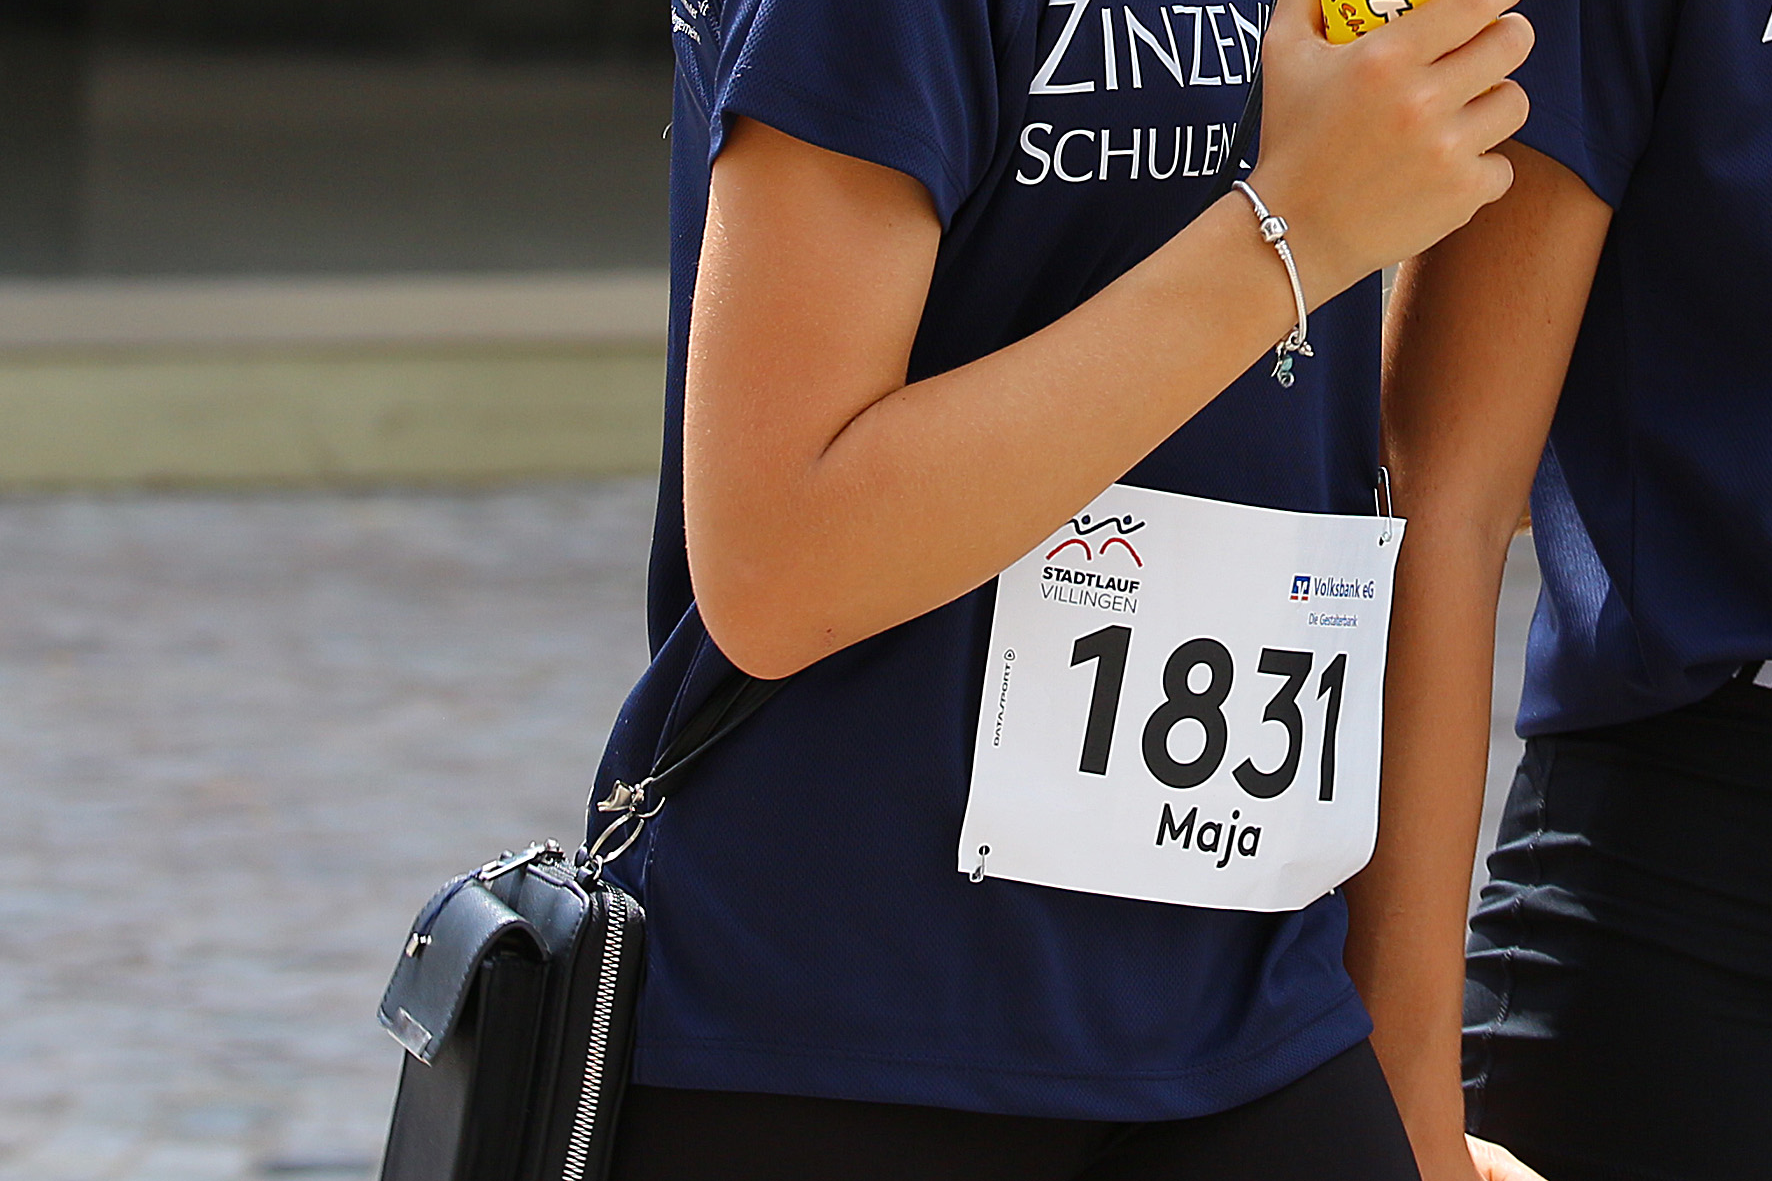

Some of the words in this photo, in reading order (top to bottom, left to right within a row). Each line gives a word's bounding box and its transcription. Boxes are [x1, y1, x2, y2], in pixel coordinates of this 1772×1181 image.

[1014, 121, 1240, 186] SCHULEN
[1042, 566, 1141, 595] STADTLAUF
[1313, 576, 1361, 598] Volksbank
[1362, 580, 1375, 599] eG
[1039, 582, 1138, 615] VILLINGEN
[1308, 612, 1319, 625] Die
[1069, 623, 1349, 803] 1831
[1155, 802, 1263, 870] Maja
